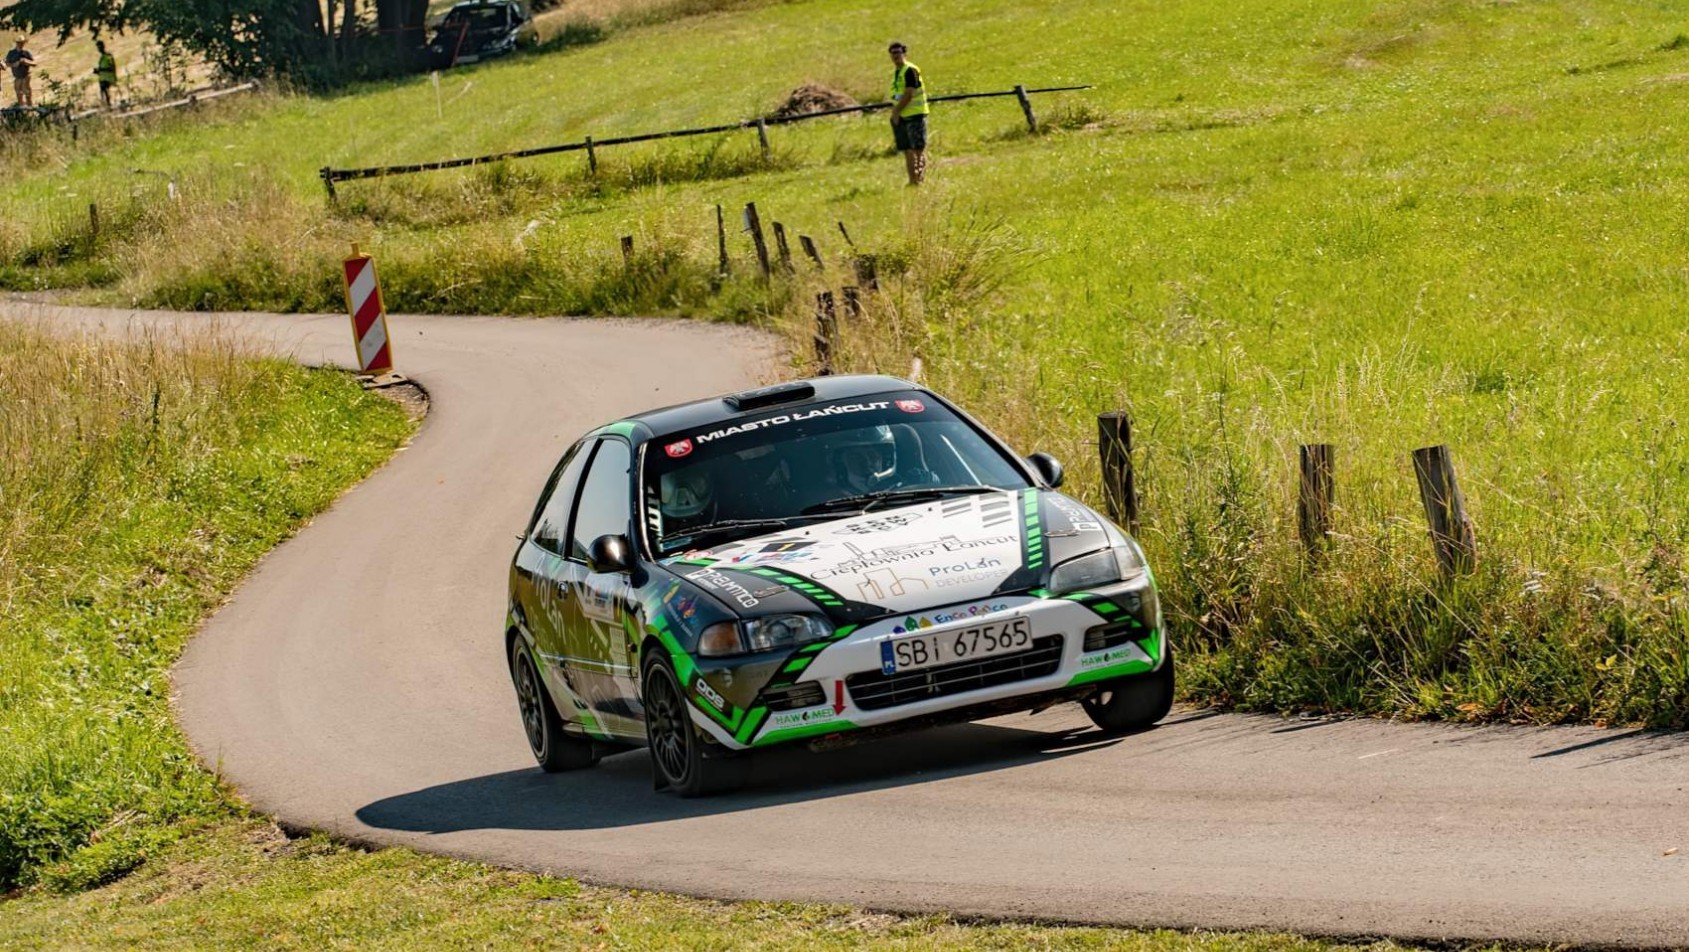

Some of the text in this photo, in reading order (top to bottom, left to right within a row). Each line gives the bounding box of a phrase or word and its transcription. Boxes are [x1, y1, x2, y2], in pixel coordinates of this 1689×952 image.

[697, 401, 890, 444] MIASTO ŁAŃCUT
[896, 621, 1028, 667] SBI 67565
